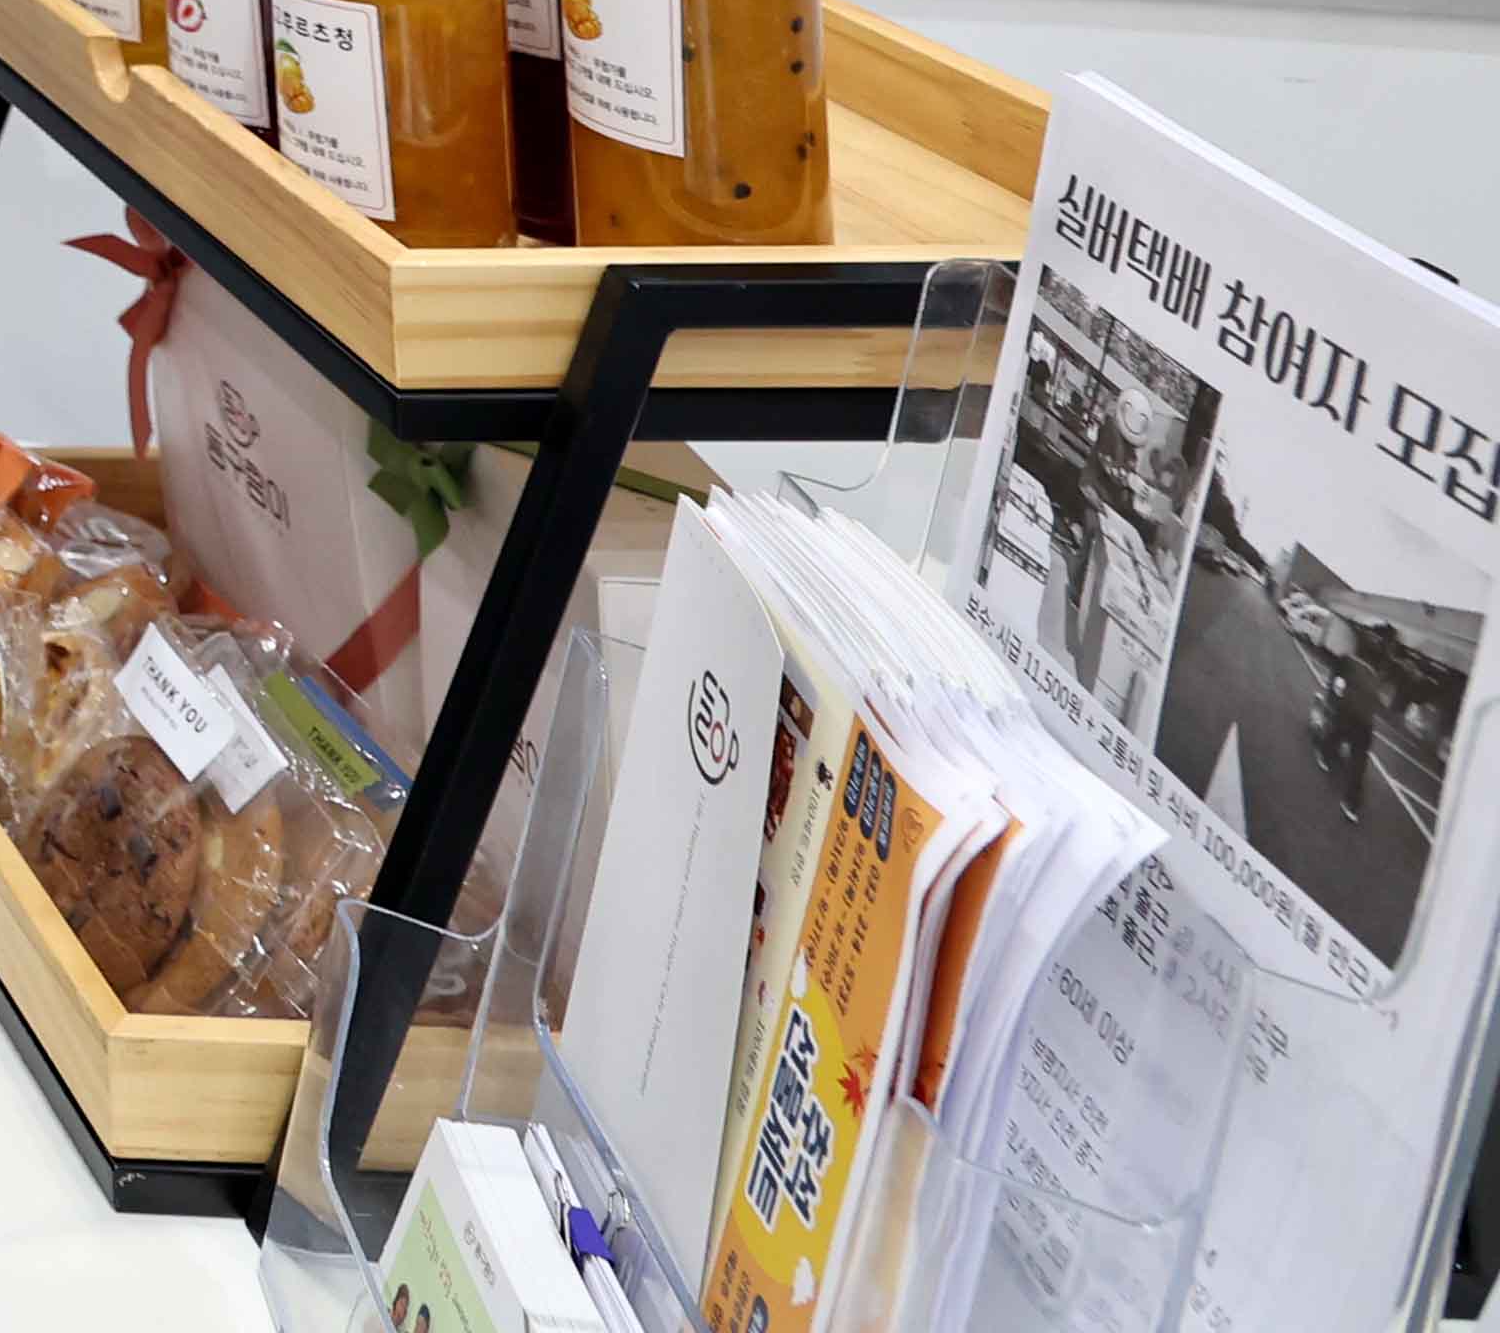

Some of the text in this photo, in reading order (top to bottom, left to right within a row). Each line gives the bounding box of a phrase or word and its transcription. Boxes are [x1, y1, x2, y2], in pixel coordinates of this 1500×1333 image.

[1056, 174, 1500, 524] 실버택배 참여자 모집
[181, 694, 208, 734] YOU
[308, 726, 342, 766] THANK
[996, 623, 1022, 664] 시급
[1023, 650, 1083, 726] 11,500원
[1098, 724, 1146, 786] 교통비
[1100, 1012, 1135, 1066] 이상
[749, 1009, 816, 1225] 선물세트
[786, 1101, 831, 1222] 추석
